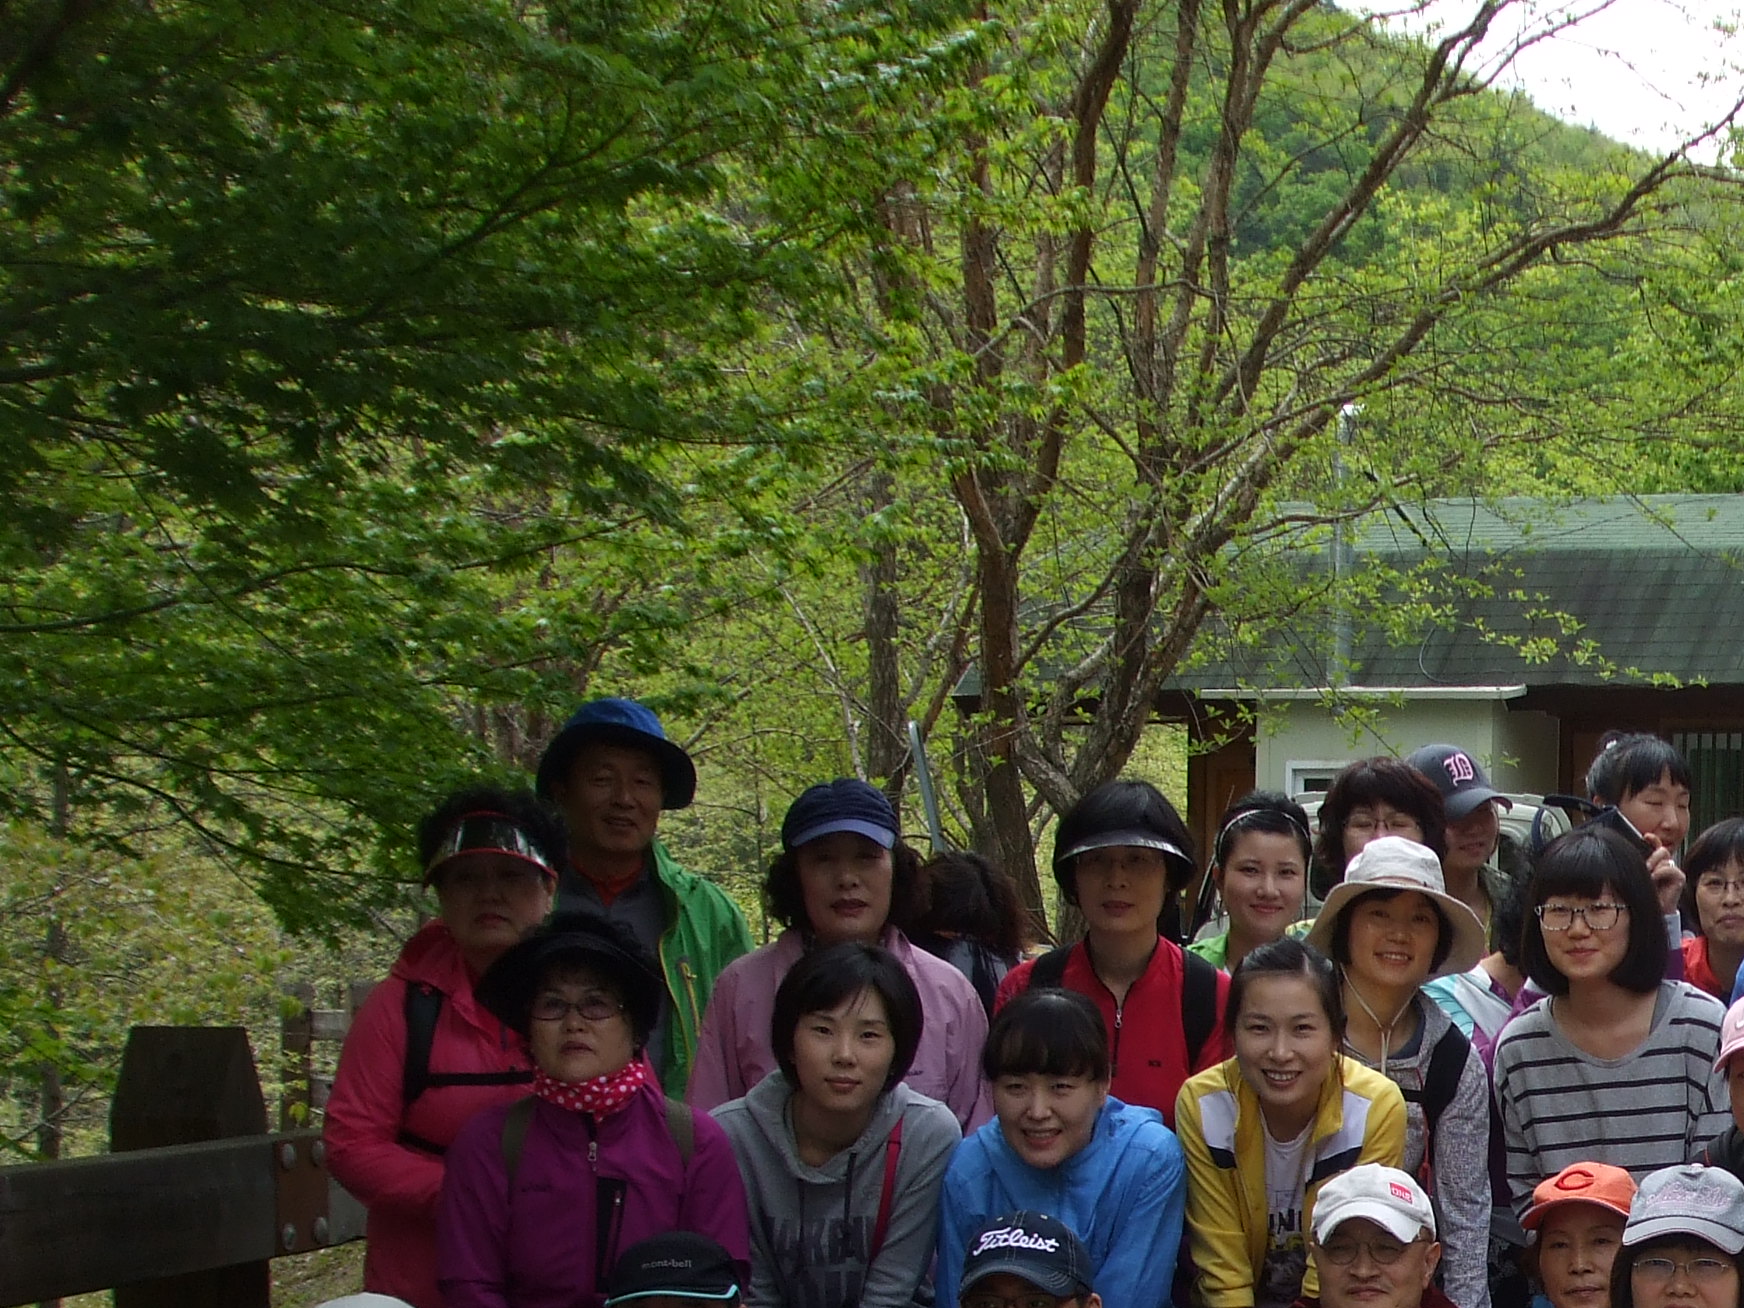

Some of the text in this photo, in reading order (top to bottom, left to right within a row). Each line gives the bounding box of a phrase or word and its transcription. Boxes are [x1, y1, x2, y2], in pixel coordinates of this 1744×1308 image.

[1555, 1170, 1595, 1191] C
[972, 1226, 1060, 1257] Titleist
[641, 1258, 692, 1269] mont-bell
